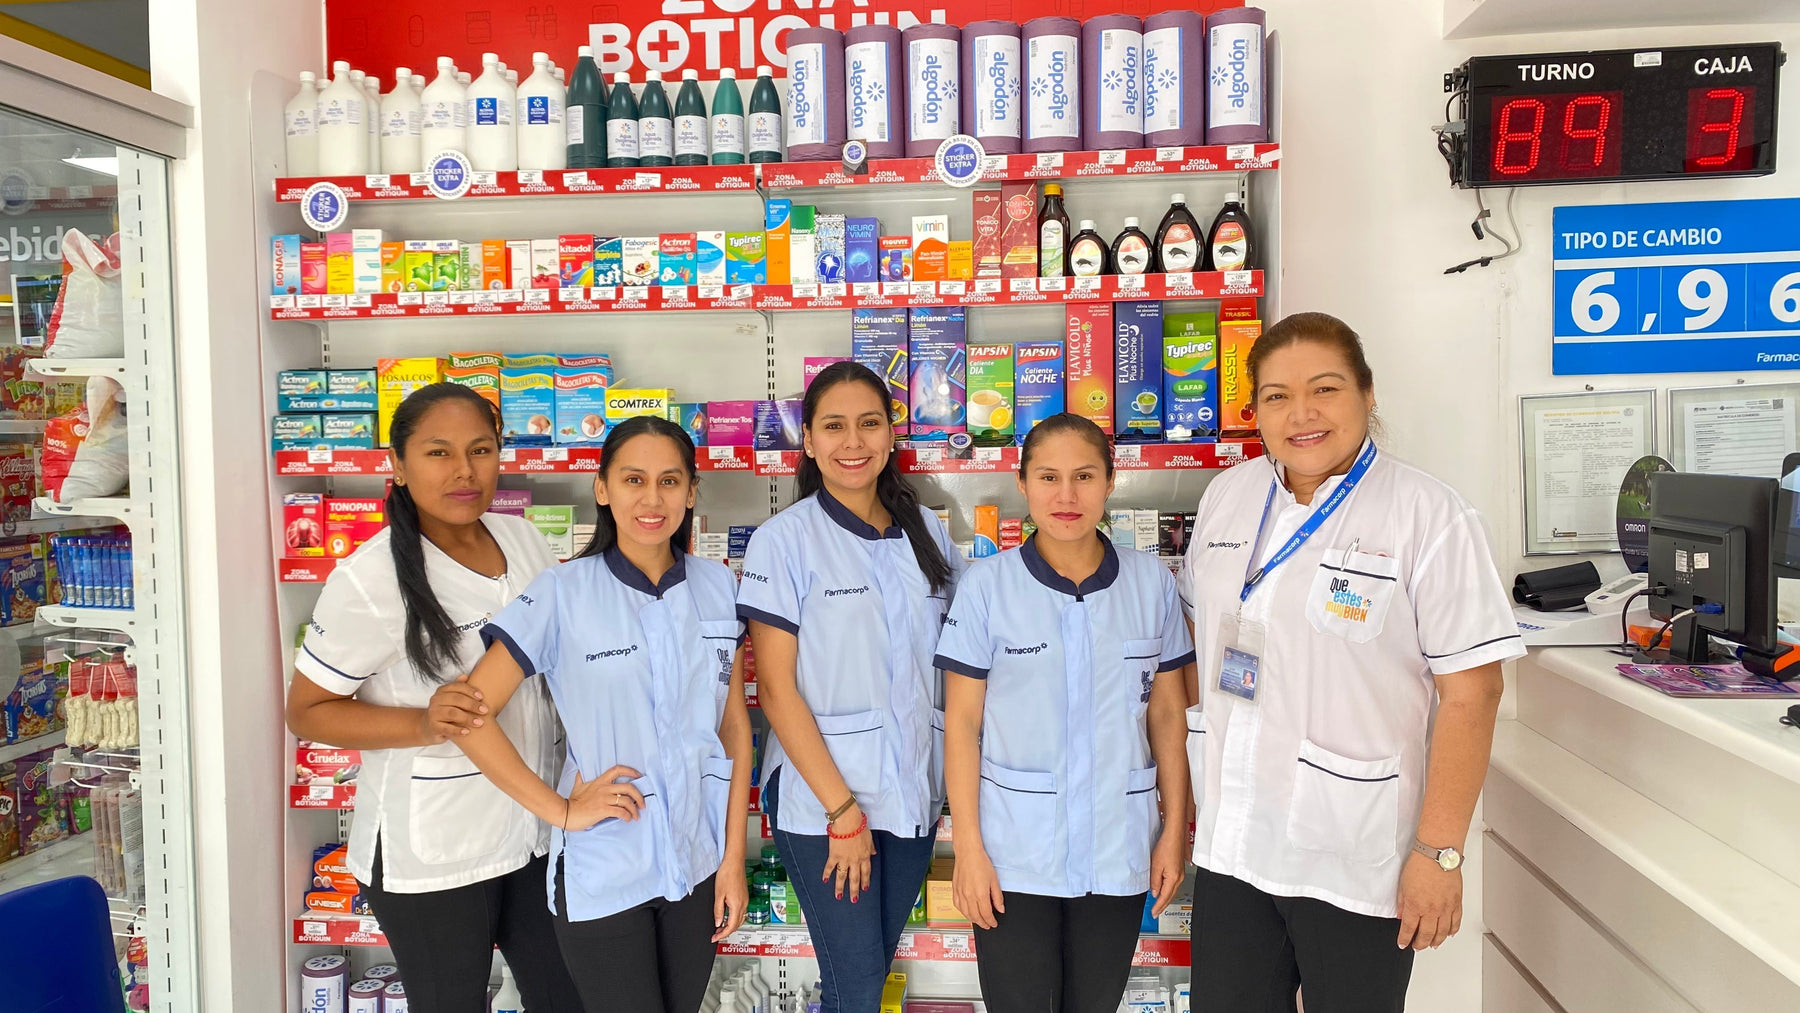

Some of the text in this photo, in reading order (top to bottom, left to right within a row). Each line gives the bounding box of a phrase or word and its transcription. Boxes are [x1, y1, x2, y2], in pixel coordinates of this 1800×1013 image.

[1228, 38, 1250, 108] algodón
[1518, 62, 1595, 81] TURNO
[1694, 56, 1753, 75] CAJA
[988, 52, 1009, 120] algodón
[1048, 51, 1068, 120] algodón
[1122, 46, 1138, 114] algodón
[1144, 49, 1158, 117] algodón
[793, 60, 810, 128] algodón
[852, 60, 866, 128] algodón
[922, 55, 942, 123] algodón
[1696, 88, 1744, 165] 3
[1494, 96, 1611, 175] 89
[946, 154, 975, 162] STICKER
[950, 160, 972, 168] EXTRA
[916, 220, 944, 232] vimin
[729, 236, 762, 246] Typirec
[1562, 228, 1722, 250] TIPO DE CAMBIO
[560, 244, 591, 252] kitadol
[462, 246, 470, 288] UCOTRIN
[970, 347, 1008, 356] TAPSIN
[1020, 348, 1058, 357] TAPSIN
[1070, 317, 1080, 381] FLAVICOLD
[1083, 333, 1092, 376] Plus Niños
[1119, 323, 1128, 384] FLAVICOLD
[1166, 342, 1212, 358] Typirec
[452, 356, 499, 368] BAGOCILETAS
[562, 358, 596, 366] BAGOCILETAS
[1756, 352, 1800, 363] Farmac
[556, 375, 602, 388] BAGOCILETAS Plus
[1020, 374, 1058, 384] NOCHE
[1225, 344, 1237, 404] TRASSIL
[288, 400, 318, 408] Actron
[609, 399, 662, 408] COMTREX
[48, 438, 67, 448] 100%
[330, 502, 376, 512] TONOPAN
[1320, 486, 1346, 516] Farmacorp
[1625, 524, 1646, 532] OMRON
[1207, 541, 1242, 550] Farmacorp
[1273, 537, 1300, 564] Farmacorp
[742, 568, 768, 584] ianex
[824, 587, 864, 597] Farmacorp
[1333, 590, 1362, 608] estés
[456, 616, 488, 633] macorp
[586, 648, 631, 662] Farmacorp
[1004, 646, 1041, 656] Farmacorp
[306, 752, 350, 764] Ciruelax
